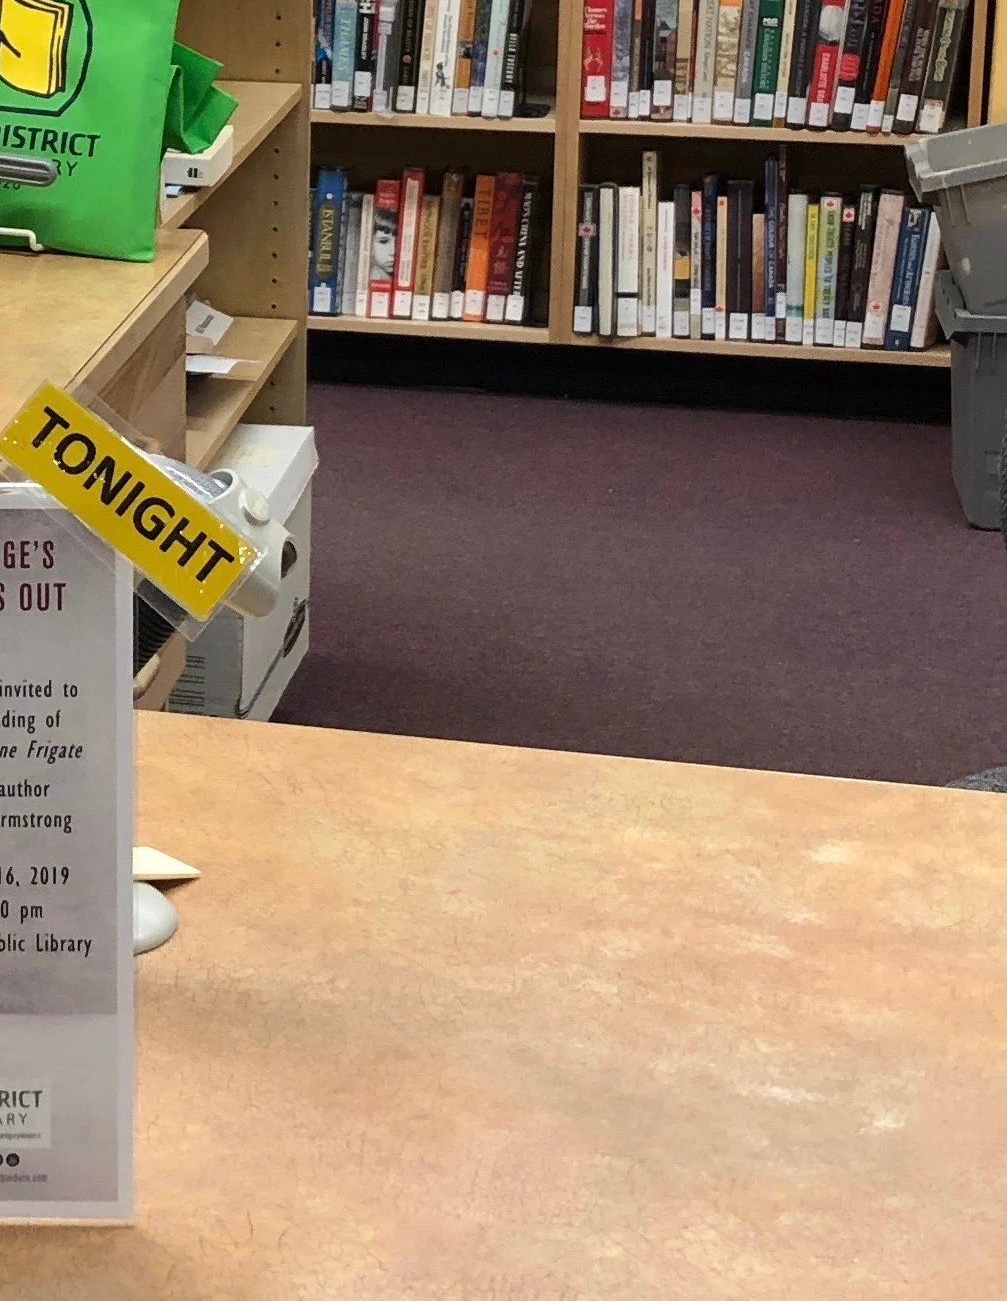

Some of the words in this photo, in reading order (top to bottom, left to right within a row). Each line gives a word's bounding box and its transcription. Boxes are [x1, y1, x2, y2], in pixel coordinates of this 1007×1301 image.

[31, 405, 235, 583] TONIGHT
[19, 583, 67, 612] OUT
[63, 682, 78, 698] to
[46, 710, 61, 728] of
[26, 739, 83, 764] Frigate
[30, 866, 69, 885] 2019
[20, 903, 43, 923] pm
[36, 934, 92, 958] Library
